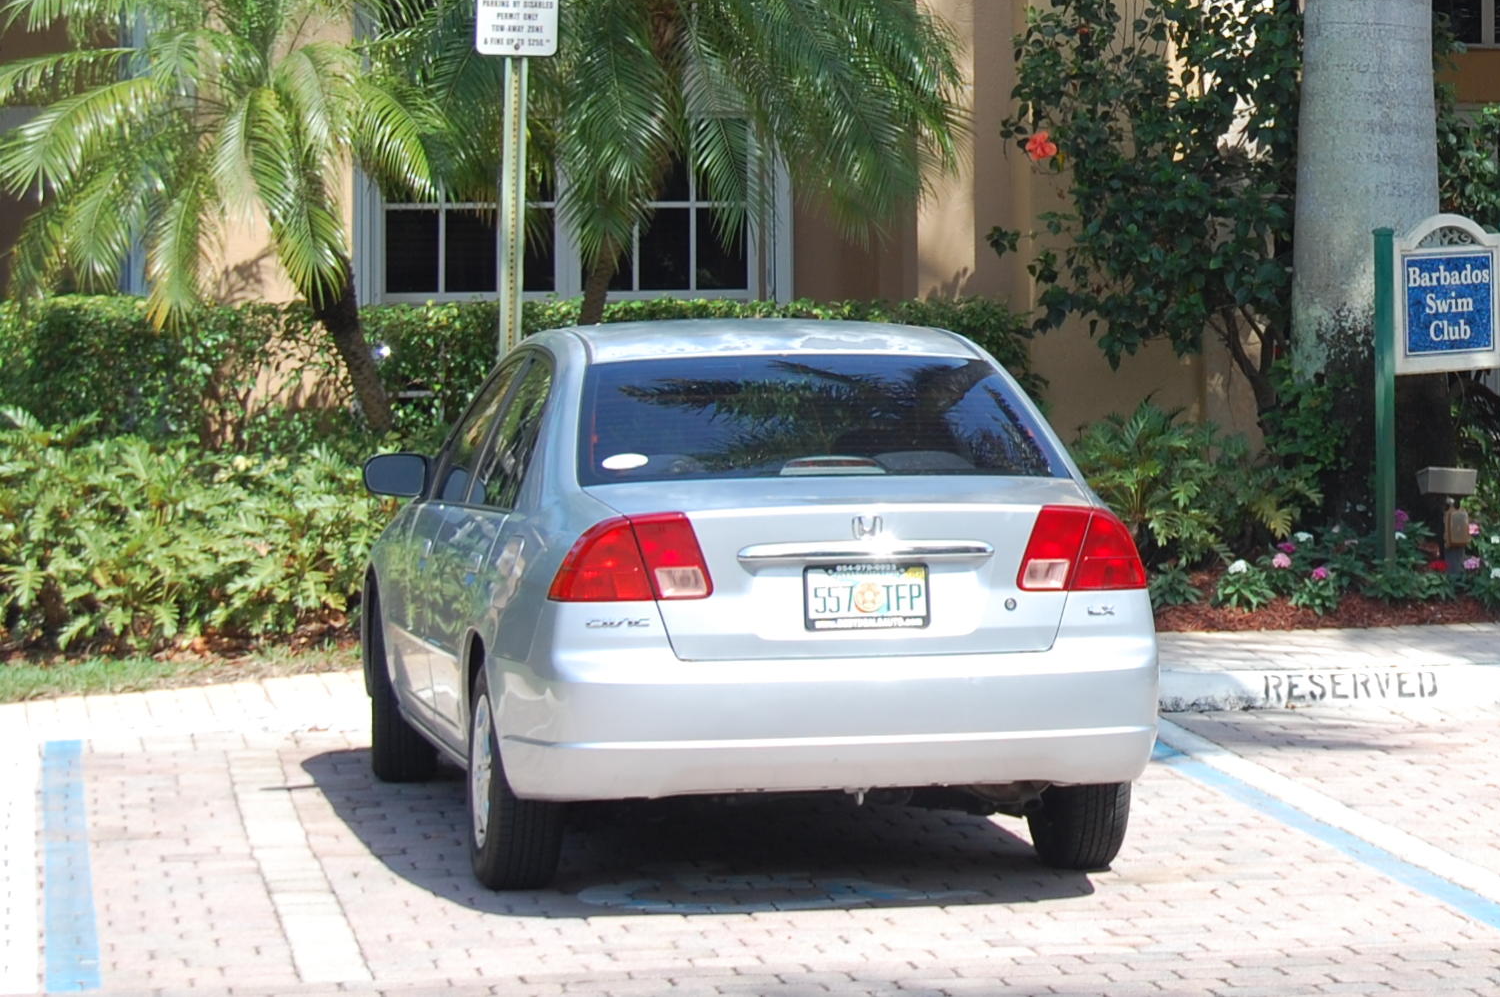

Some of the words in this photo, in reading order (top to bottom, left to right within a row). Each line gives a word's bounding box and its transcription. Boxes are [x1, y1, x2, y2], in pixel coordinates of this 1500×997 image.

[482, 0, 509, 8] PARKING
[523, 1, 553, 9] DISABLED
[496, 12, 520, 20] PERMIT
[527, 25, 544, 33] ZONE
[490, 37, 504, 45] FINE
[1408, 264, 1490, 287] Barbados
[1425, 291, 1473, 314] Swim
[1429, 319, 1471, 341] Club
[814, 585, 854, 613] 557
[881, 583, 922, 611] TFP
[1087, 605, 1116, 616] LX
[1262, 670, 1438, 702] RESERVED
